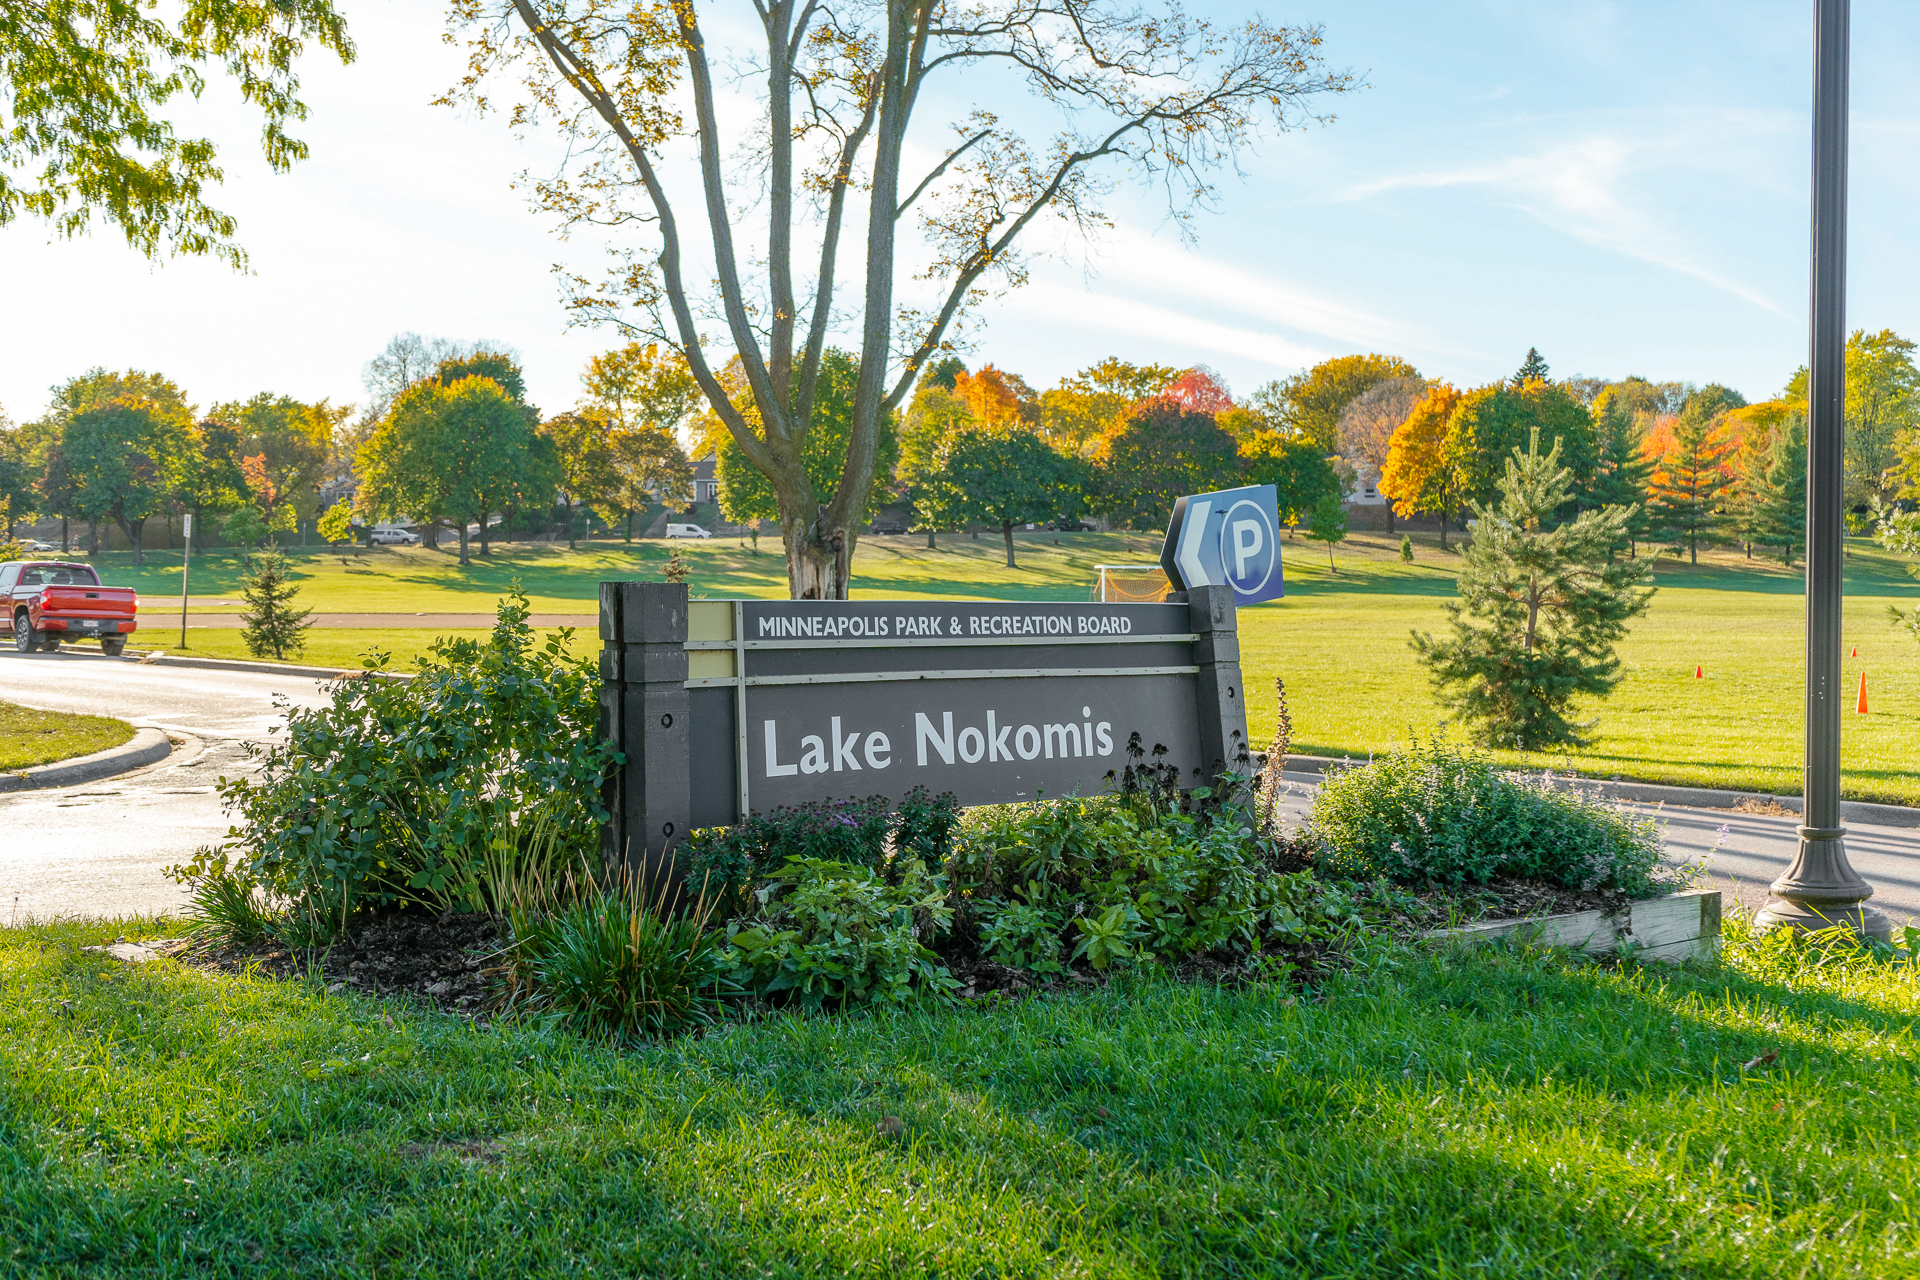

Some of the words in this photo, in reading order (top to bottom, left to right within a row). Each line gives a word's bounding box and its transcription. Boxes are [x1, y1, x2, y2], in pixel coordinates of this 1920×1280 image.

[1232, 518, 1264, 581] P
[758, 616, 889, 637] MINNEAPOLIS
[895, 616, 943, 636] PARK
[949, 616, 964, 635] &
[969, 615, 1073, 635] RECREATION
[1077, 615, 1132, 634] BOARD
[764, 715, 892, 778] Lake
[914, 705, 1115, 767] Nokomis
